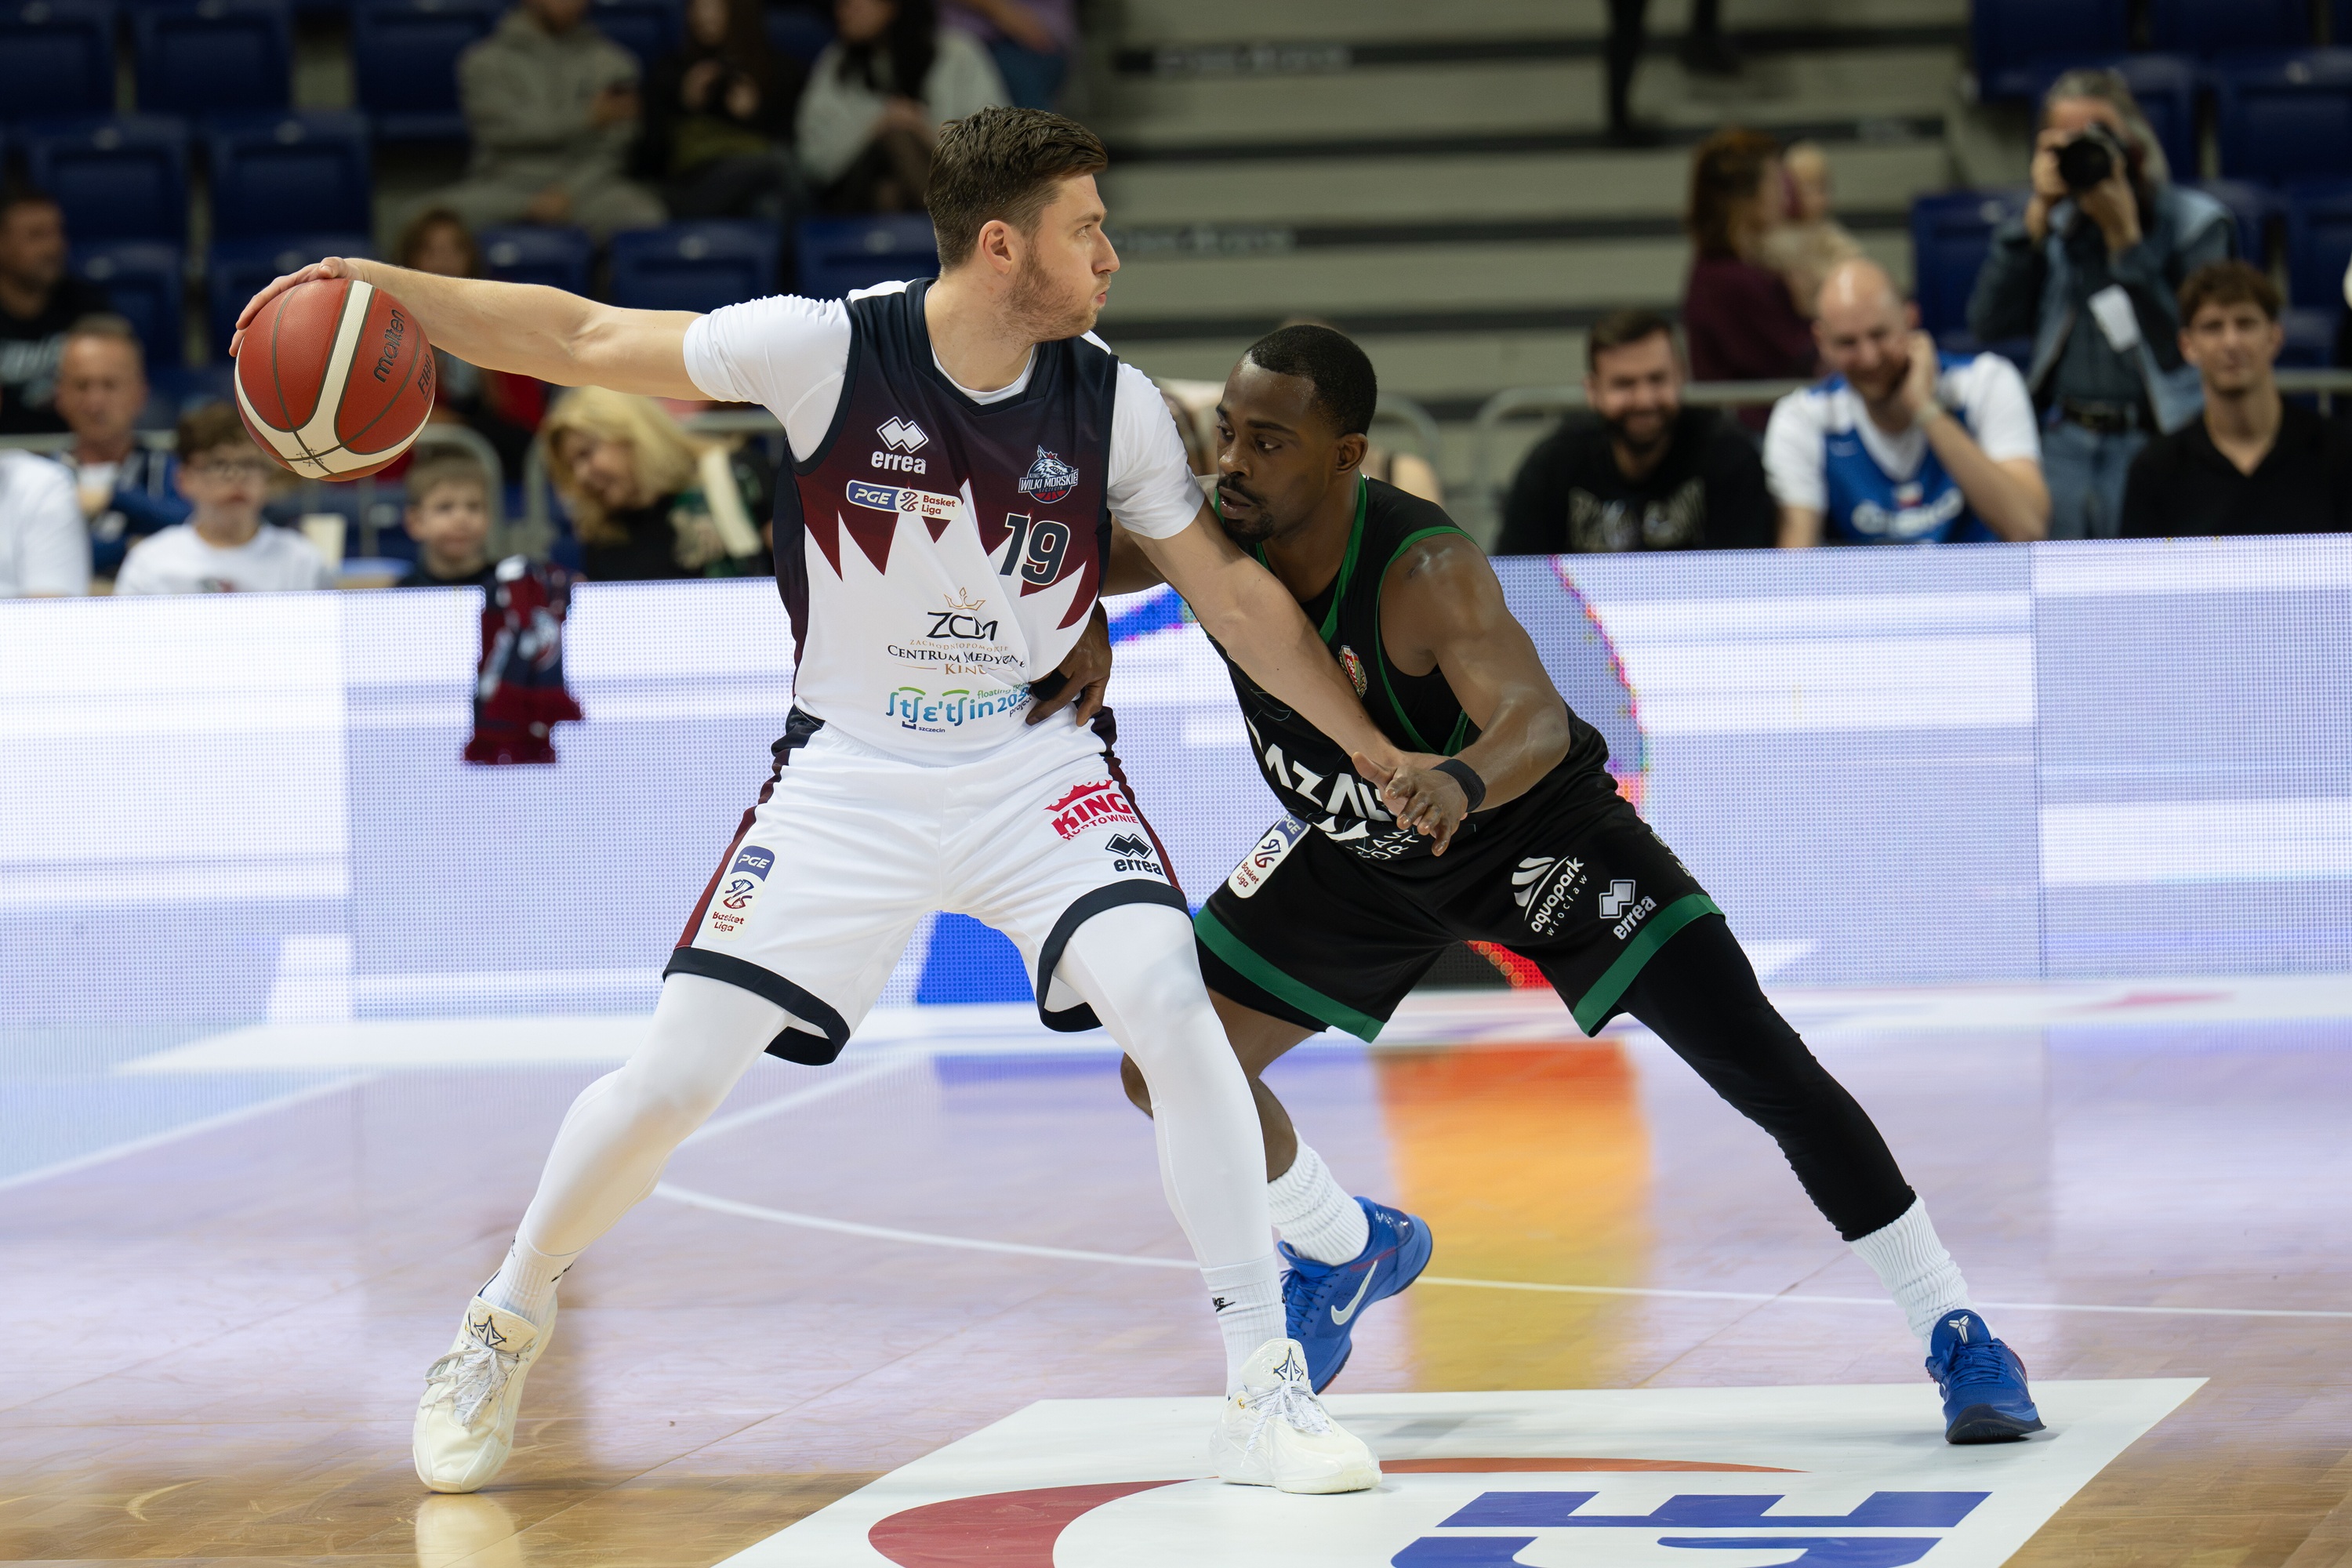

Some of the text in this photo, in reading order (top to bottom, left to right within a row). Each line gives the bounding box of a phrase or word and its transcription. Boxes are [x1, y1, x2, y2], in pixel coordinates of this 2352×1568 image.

[373, 309, 405, 383] molten
[417, 353, 433, 395] FIBA
[1021, 471, 1078, 491] WILKI MORSKIE
[855, 488, 956, 507] PGE Basket
[921, 504, 942, 515] Liga
[999, 512, 1070, 586] 19
[926, 612, 998, 641] ZCM
[887, 644, 961, 663] CENTRUM
[1051, 793, 1132, 836] KING
[1283, 815, 1301, 835] PGE
[738, 854, 770, 869] PGE
[1236, 872, 1249, 887] Liga
[1241, 862, 1260, 884] Basket
[1530, 857, 1584, 933] aquapark
[712, 911, 745, 924] Basket
[713, 921, 734, 932] Liga
